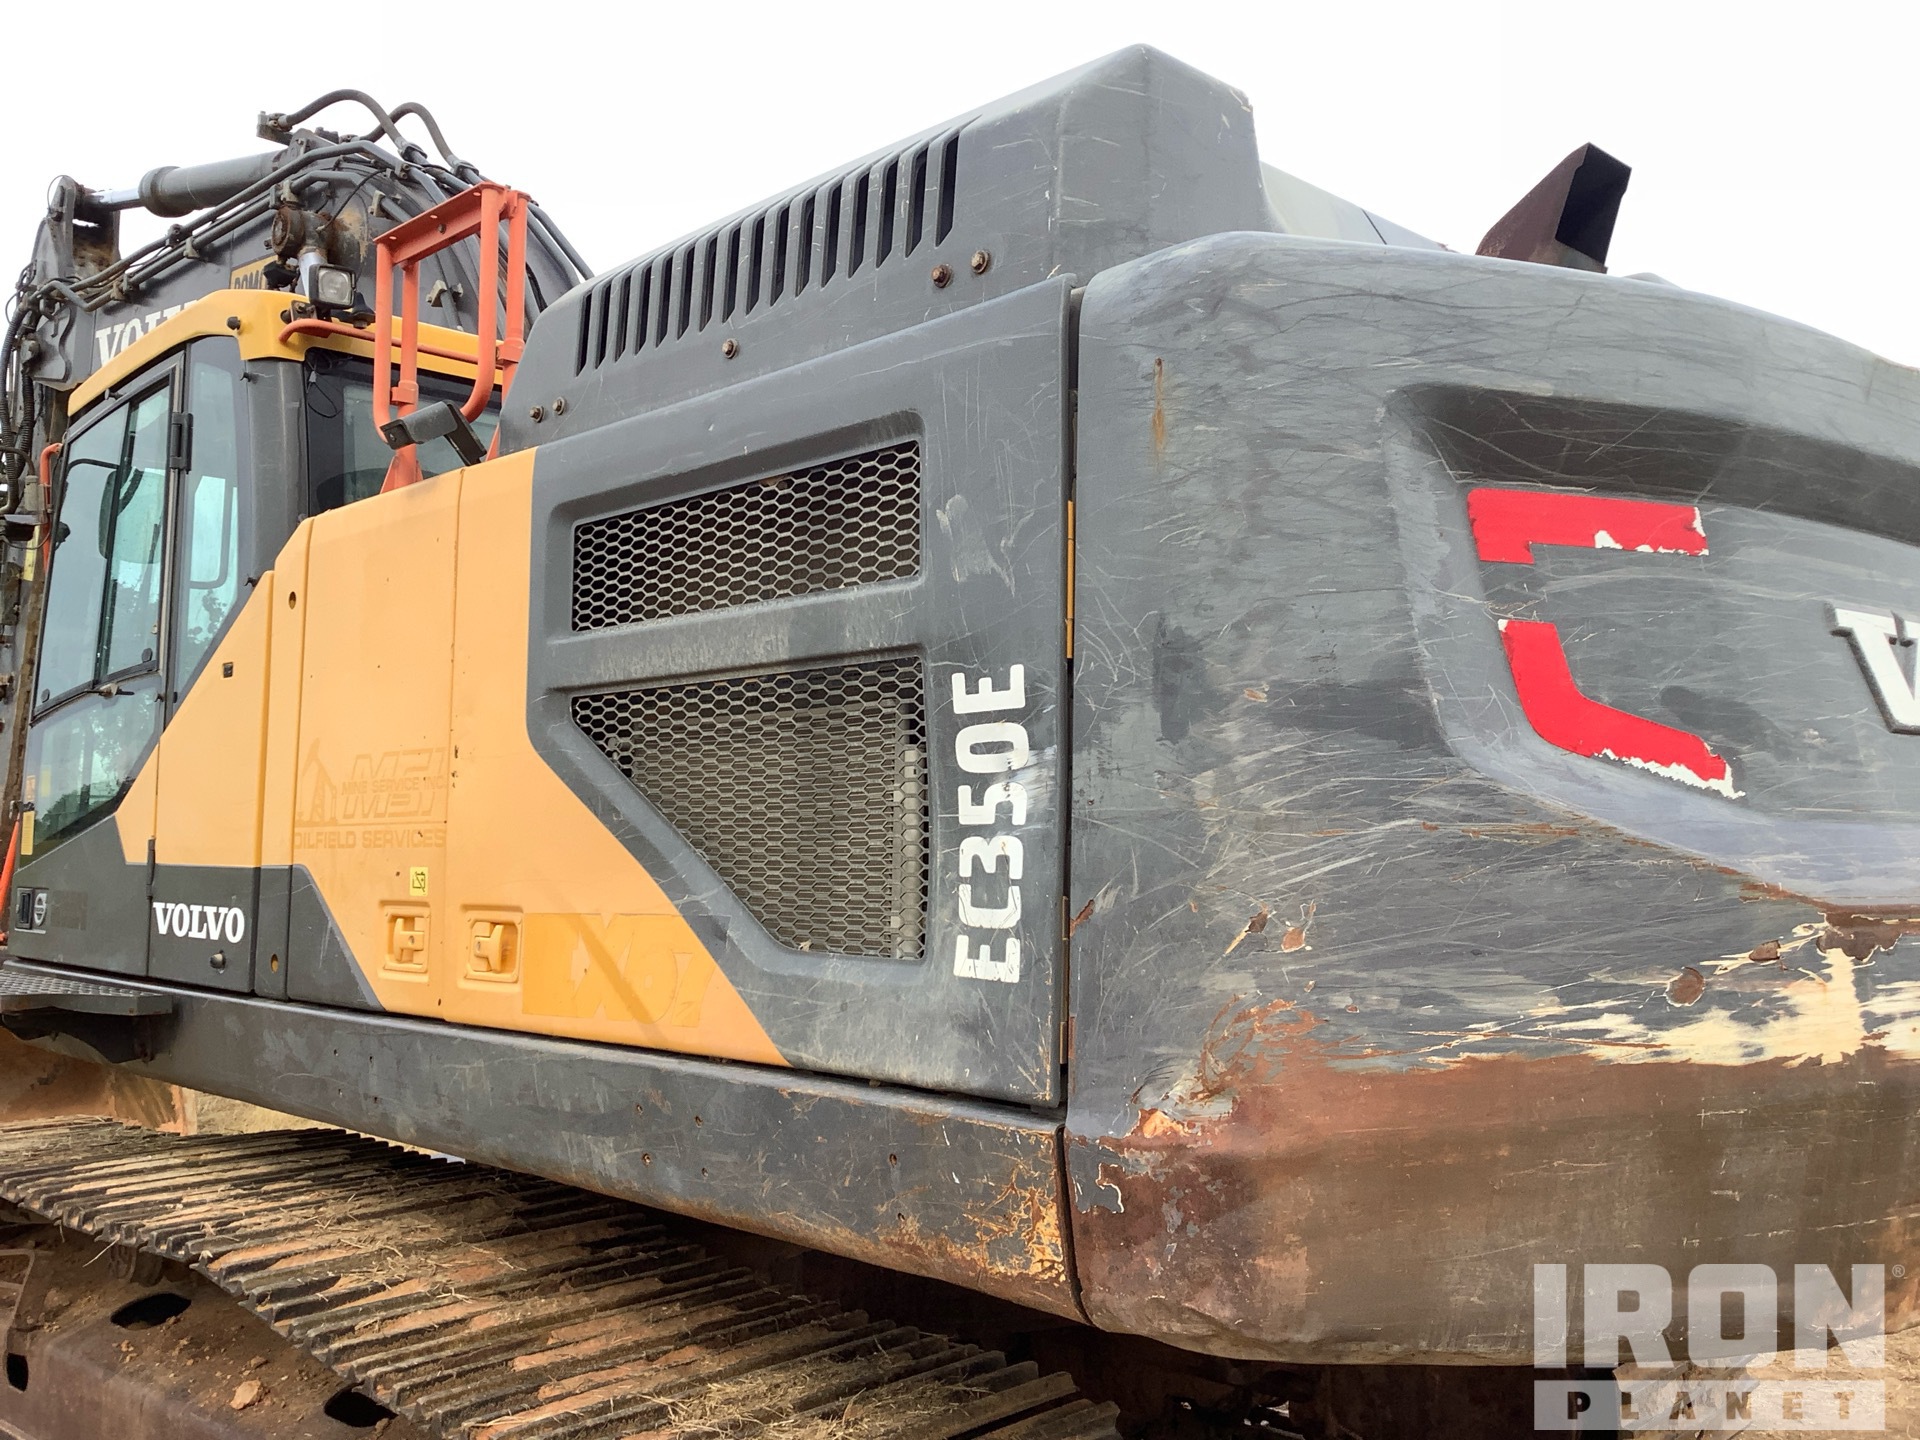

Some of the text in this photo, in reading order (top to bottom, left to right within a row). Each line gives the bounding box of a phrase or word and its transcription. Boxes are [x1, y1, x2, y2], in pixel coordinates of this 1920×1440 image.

[362, 829, 446, 848] SERVICES
[952, 664, 1029, 983] EC350E
[153, 902, 245, 943] VOLVO
